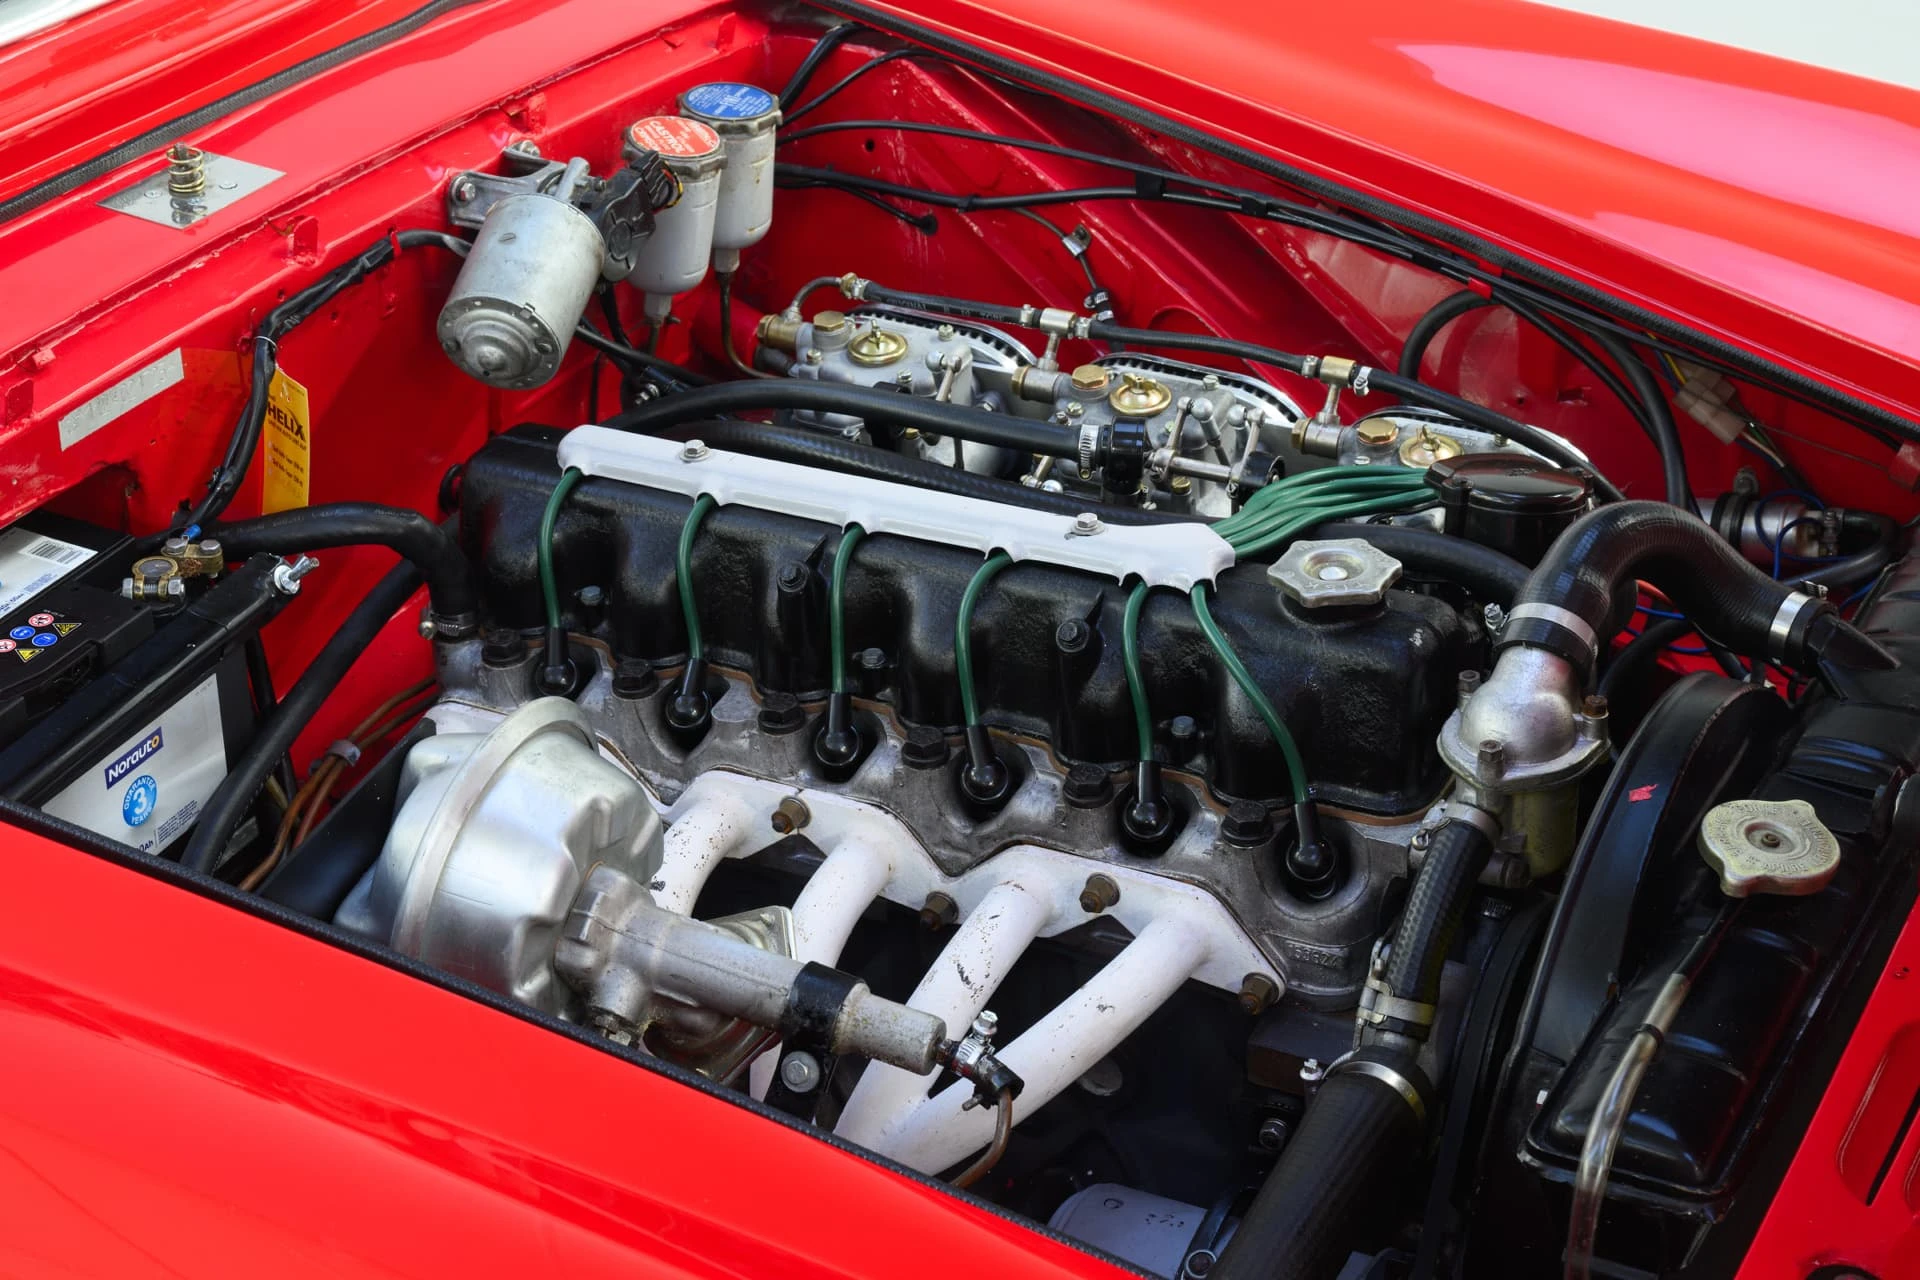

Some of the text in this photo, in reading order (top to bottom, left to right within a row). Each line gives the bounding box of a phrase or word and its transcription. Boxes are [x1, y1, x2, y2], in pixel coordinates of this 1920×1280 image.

[650, 120, 686, 154] CASTROL
[267, 402, 305, 441] HELIX
[108, 735, 160, 782] Norauto
[133, 787, 147, 815] 3
